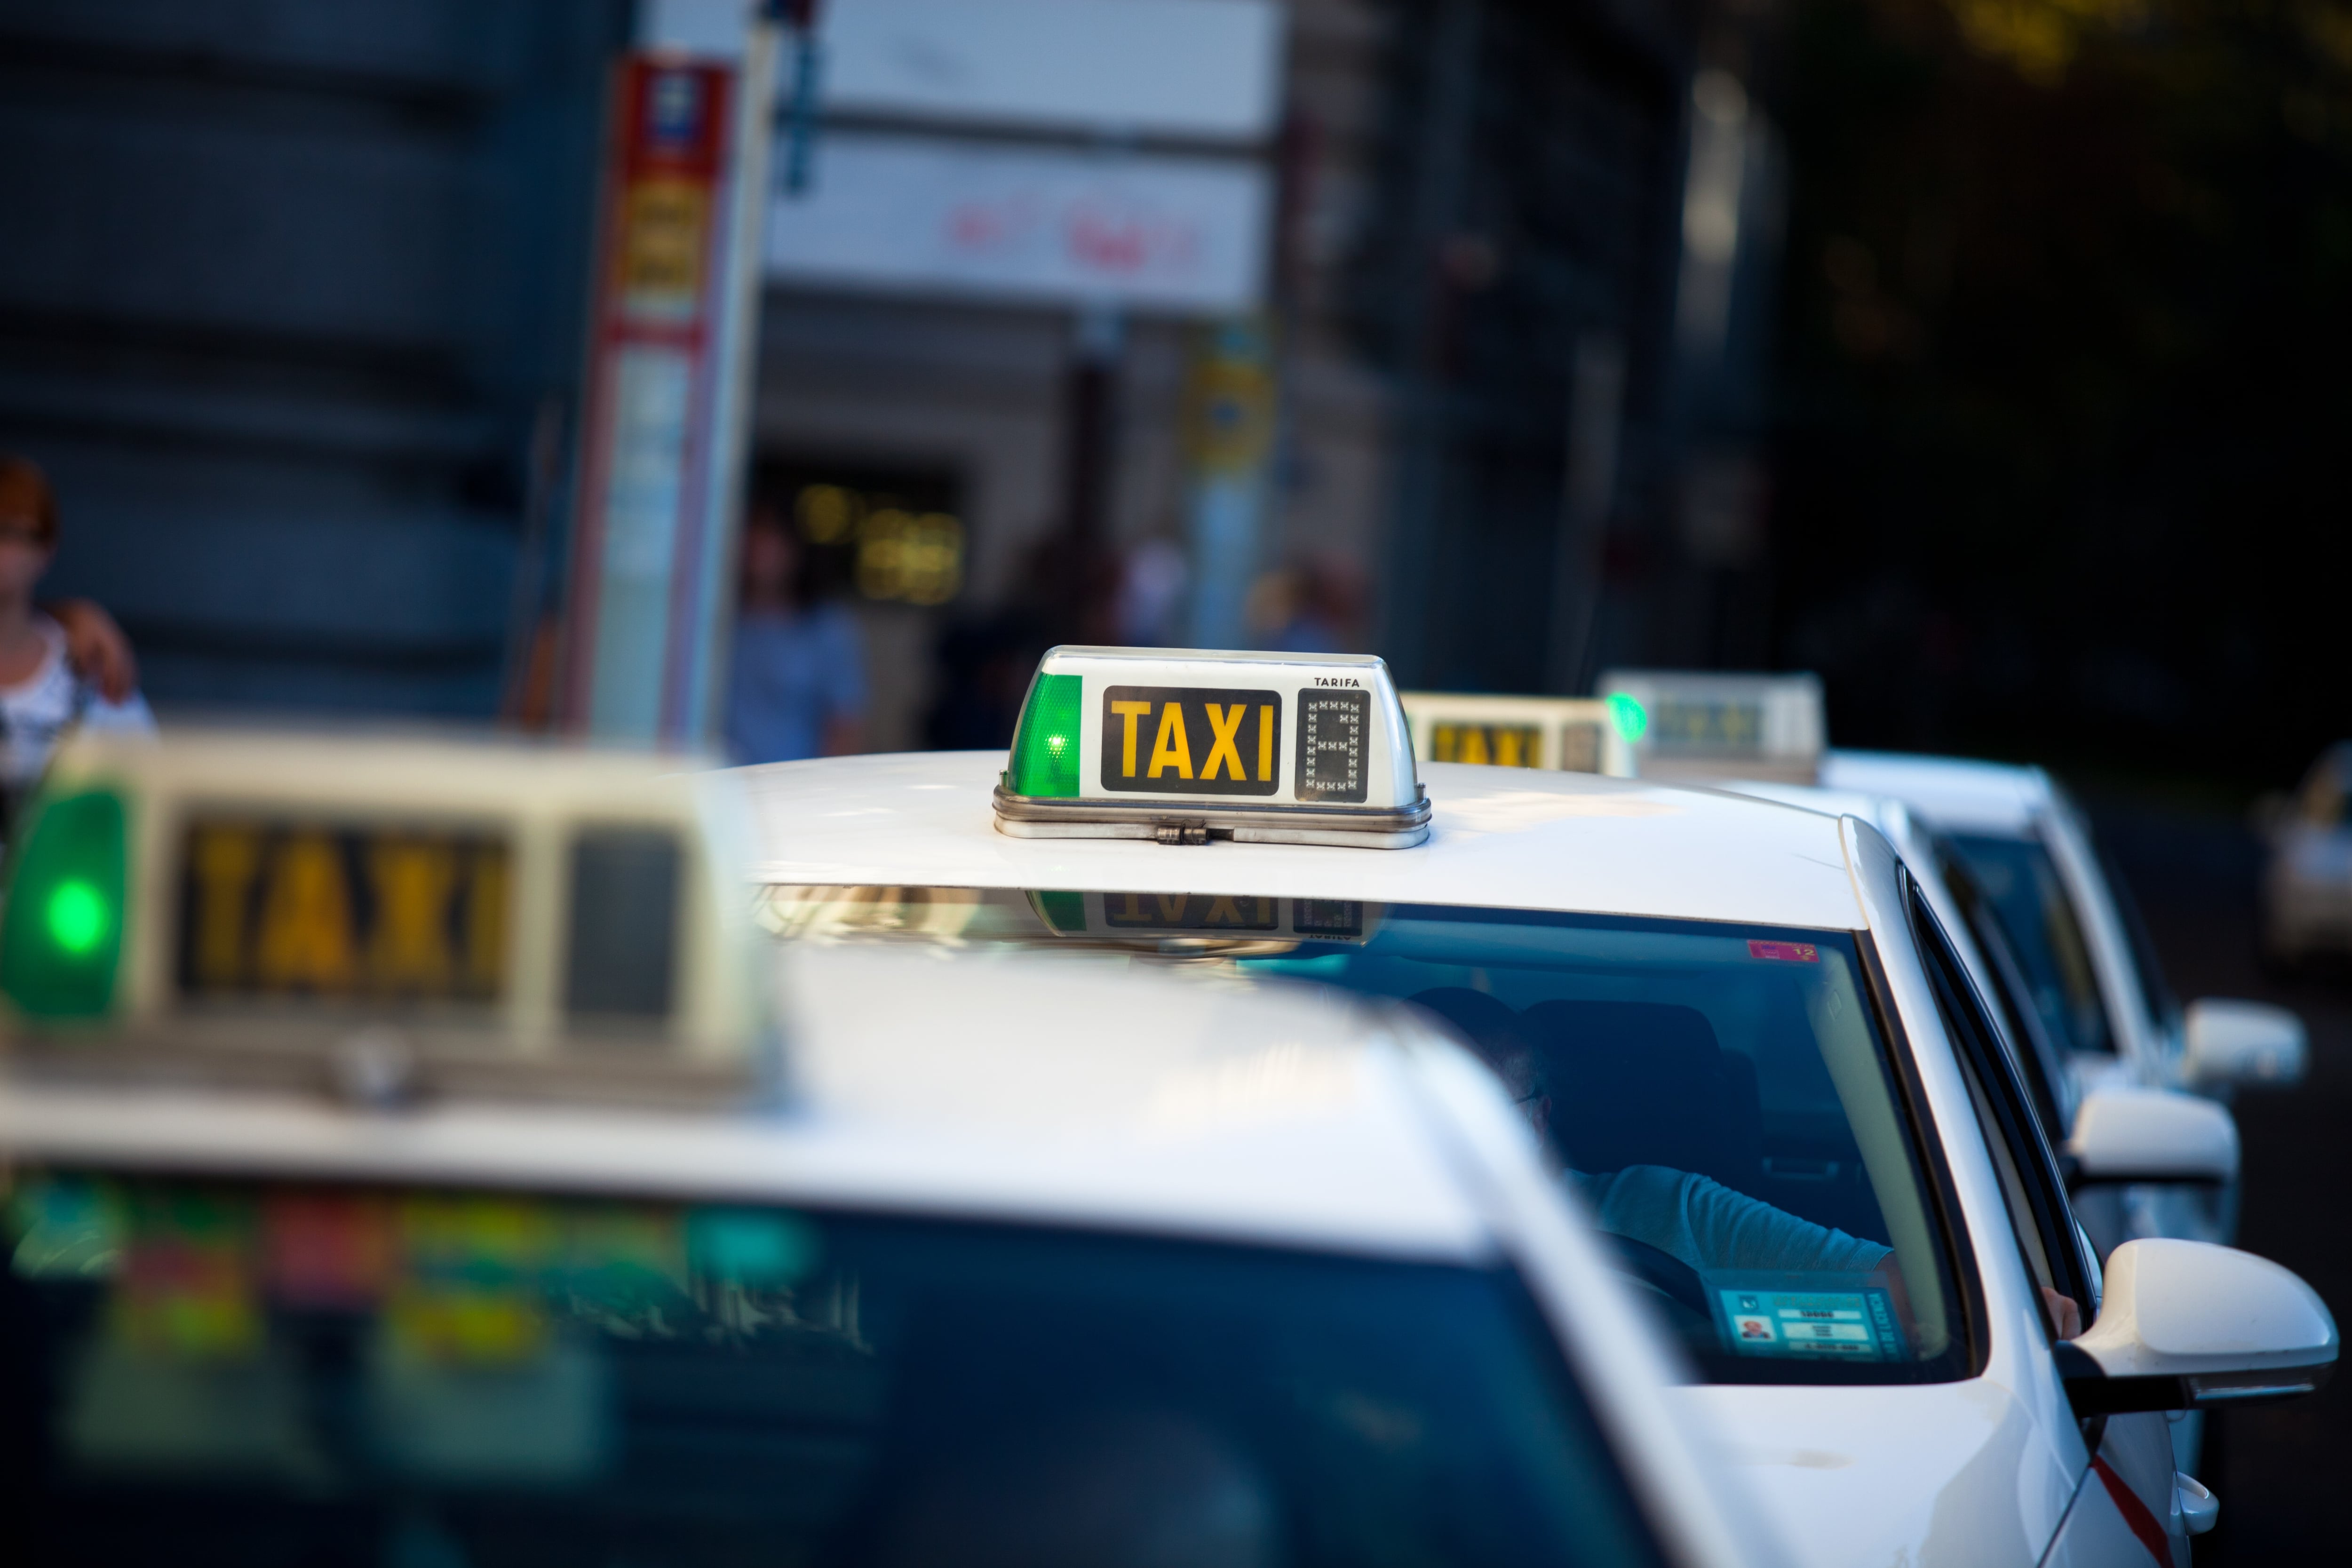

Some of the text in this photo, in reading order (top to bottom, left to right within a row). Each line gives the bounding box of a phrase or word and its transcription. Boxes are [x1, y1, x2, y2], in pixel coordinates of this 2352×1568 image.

[1314, 677, 1360, 688] TARIFA
[1111, 700, 1273, 781] TAXI
[191, 824, 513, 992] TAXI
[1793, 948, 1815, 957] 12
